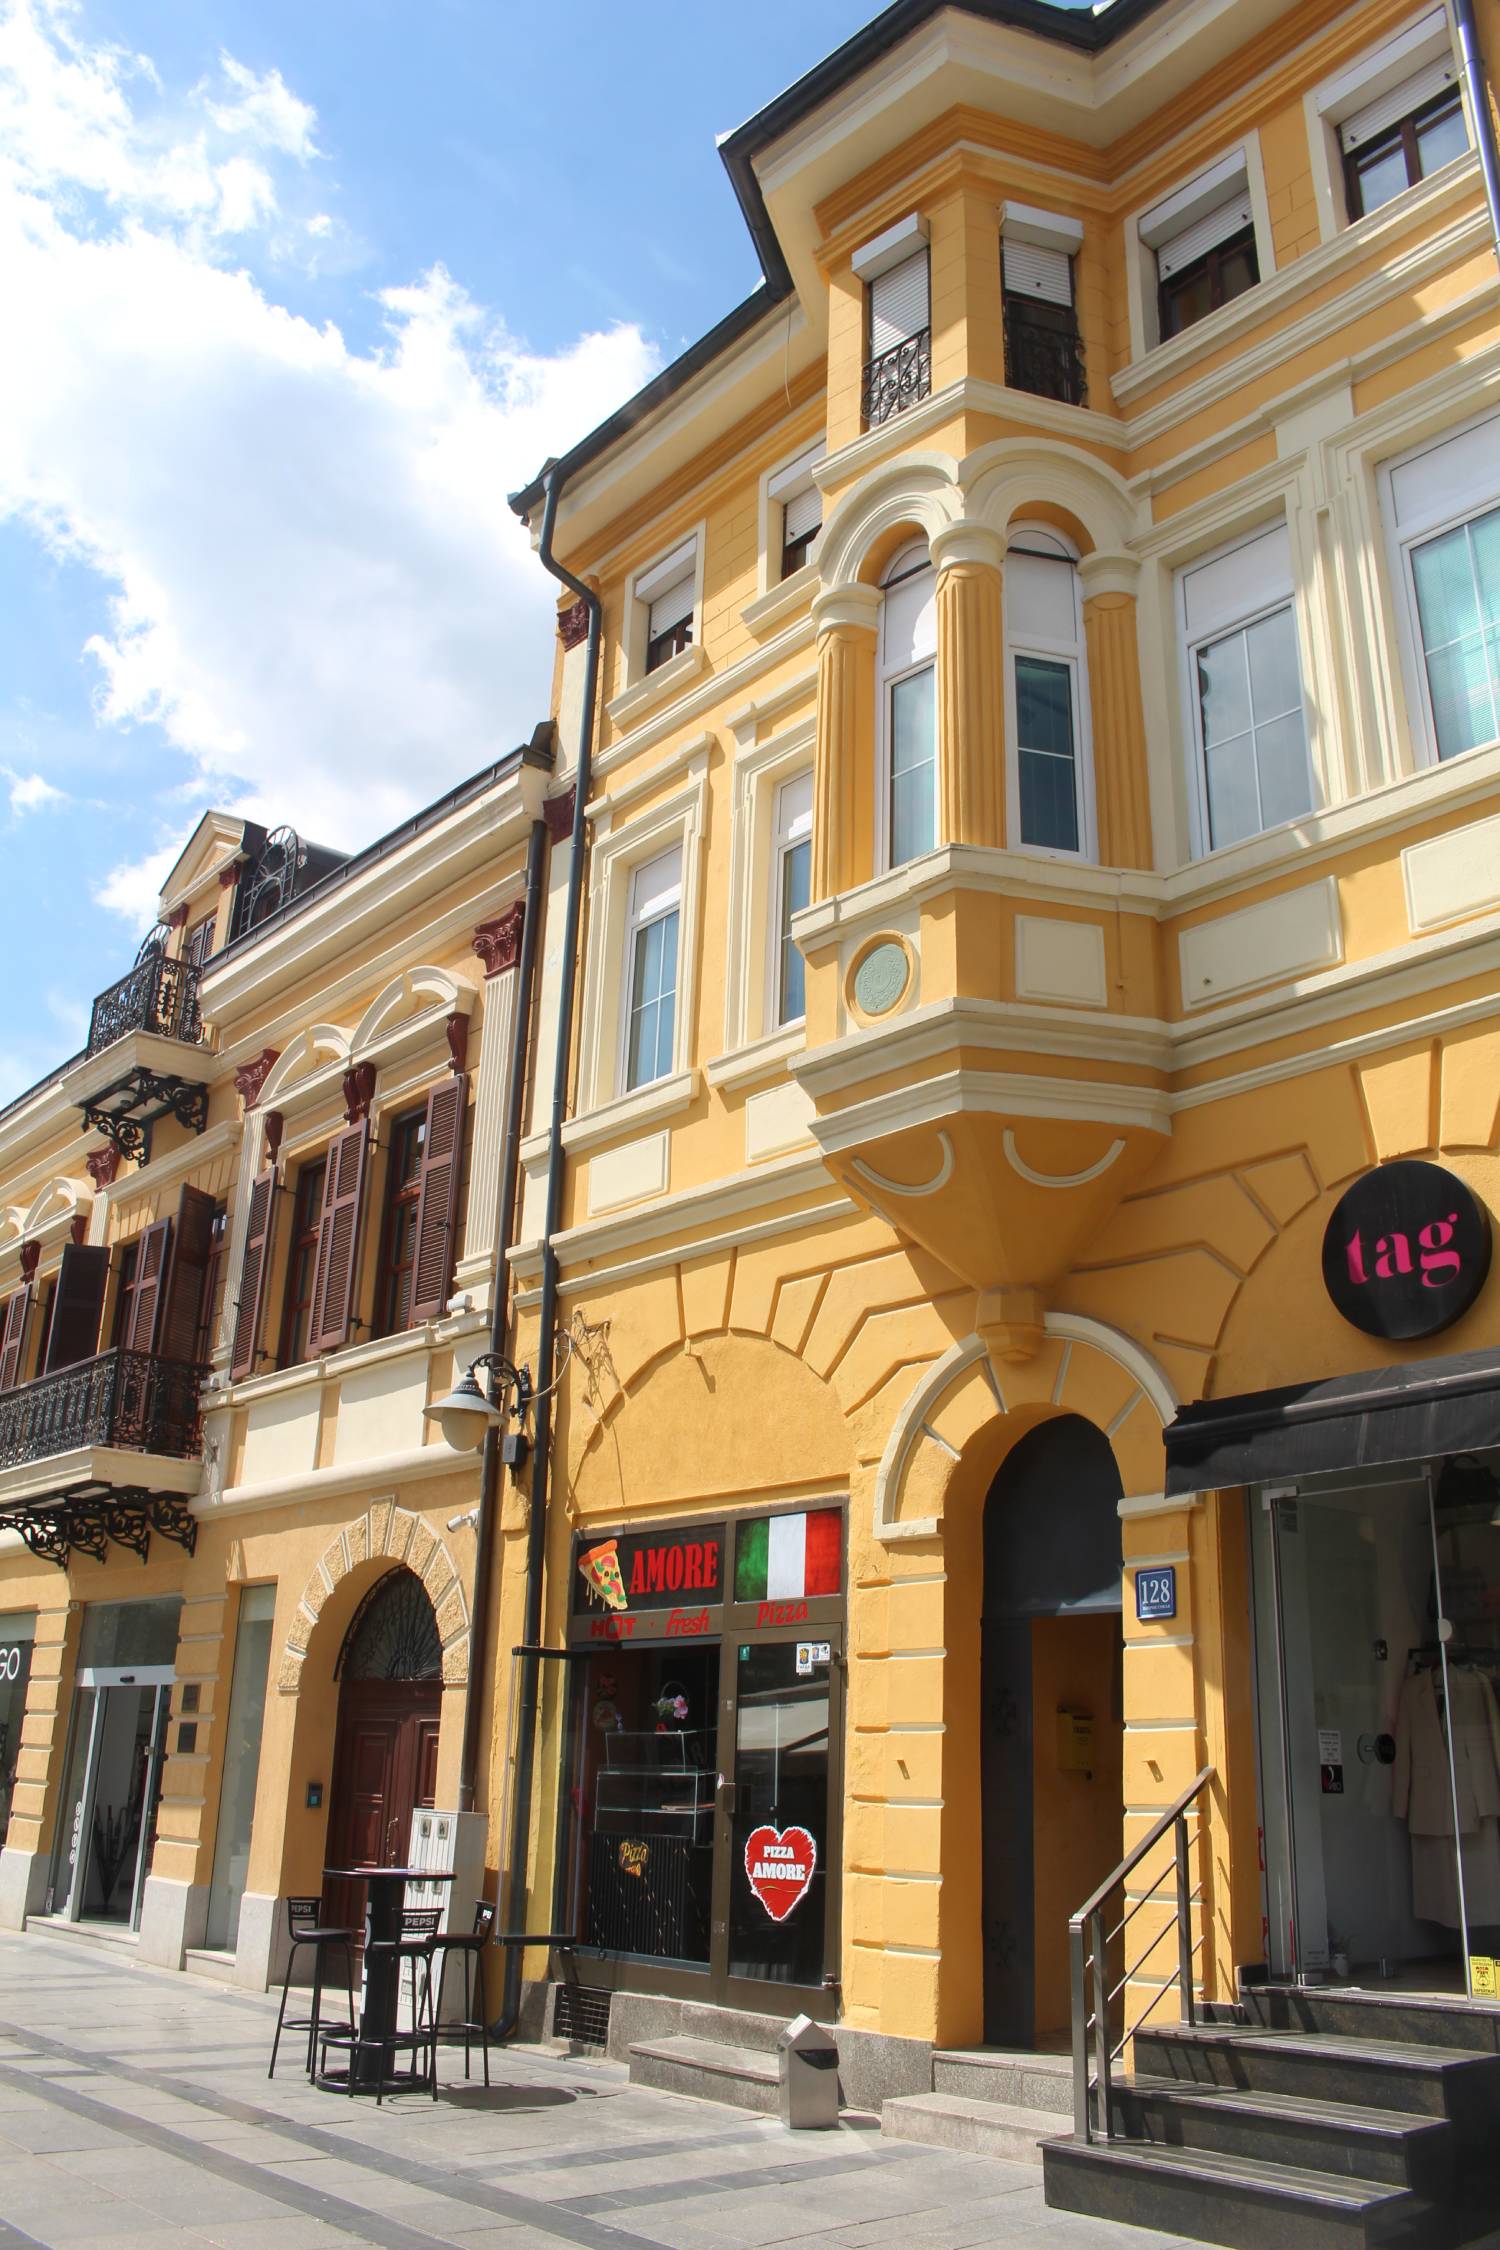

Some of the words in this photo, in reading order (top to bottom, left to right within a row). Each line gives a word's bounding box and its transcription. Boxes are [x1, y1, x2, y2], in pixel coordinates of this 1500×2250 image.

[1346, 1212, 1461, 1288] tag
[629, 1541, 719, 1595] AMORE
[1141, 1578, 1171, 1604] 128
[591, 1615, 637, 1640] HOT
[755, 1600, 808, 1629] Pizza
[763, 1845, 795, 1859] PIZZA
[752, 1862, 806, 1880] AMORE
[404, 1917, 435, 1926] PEPSI
